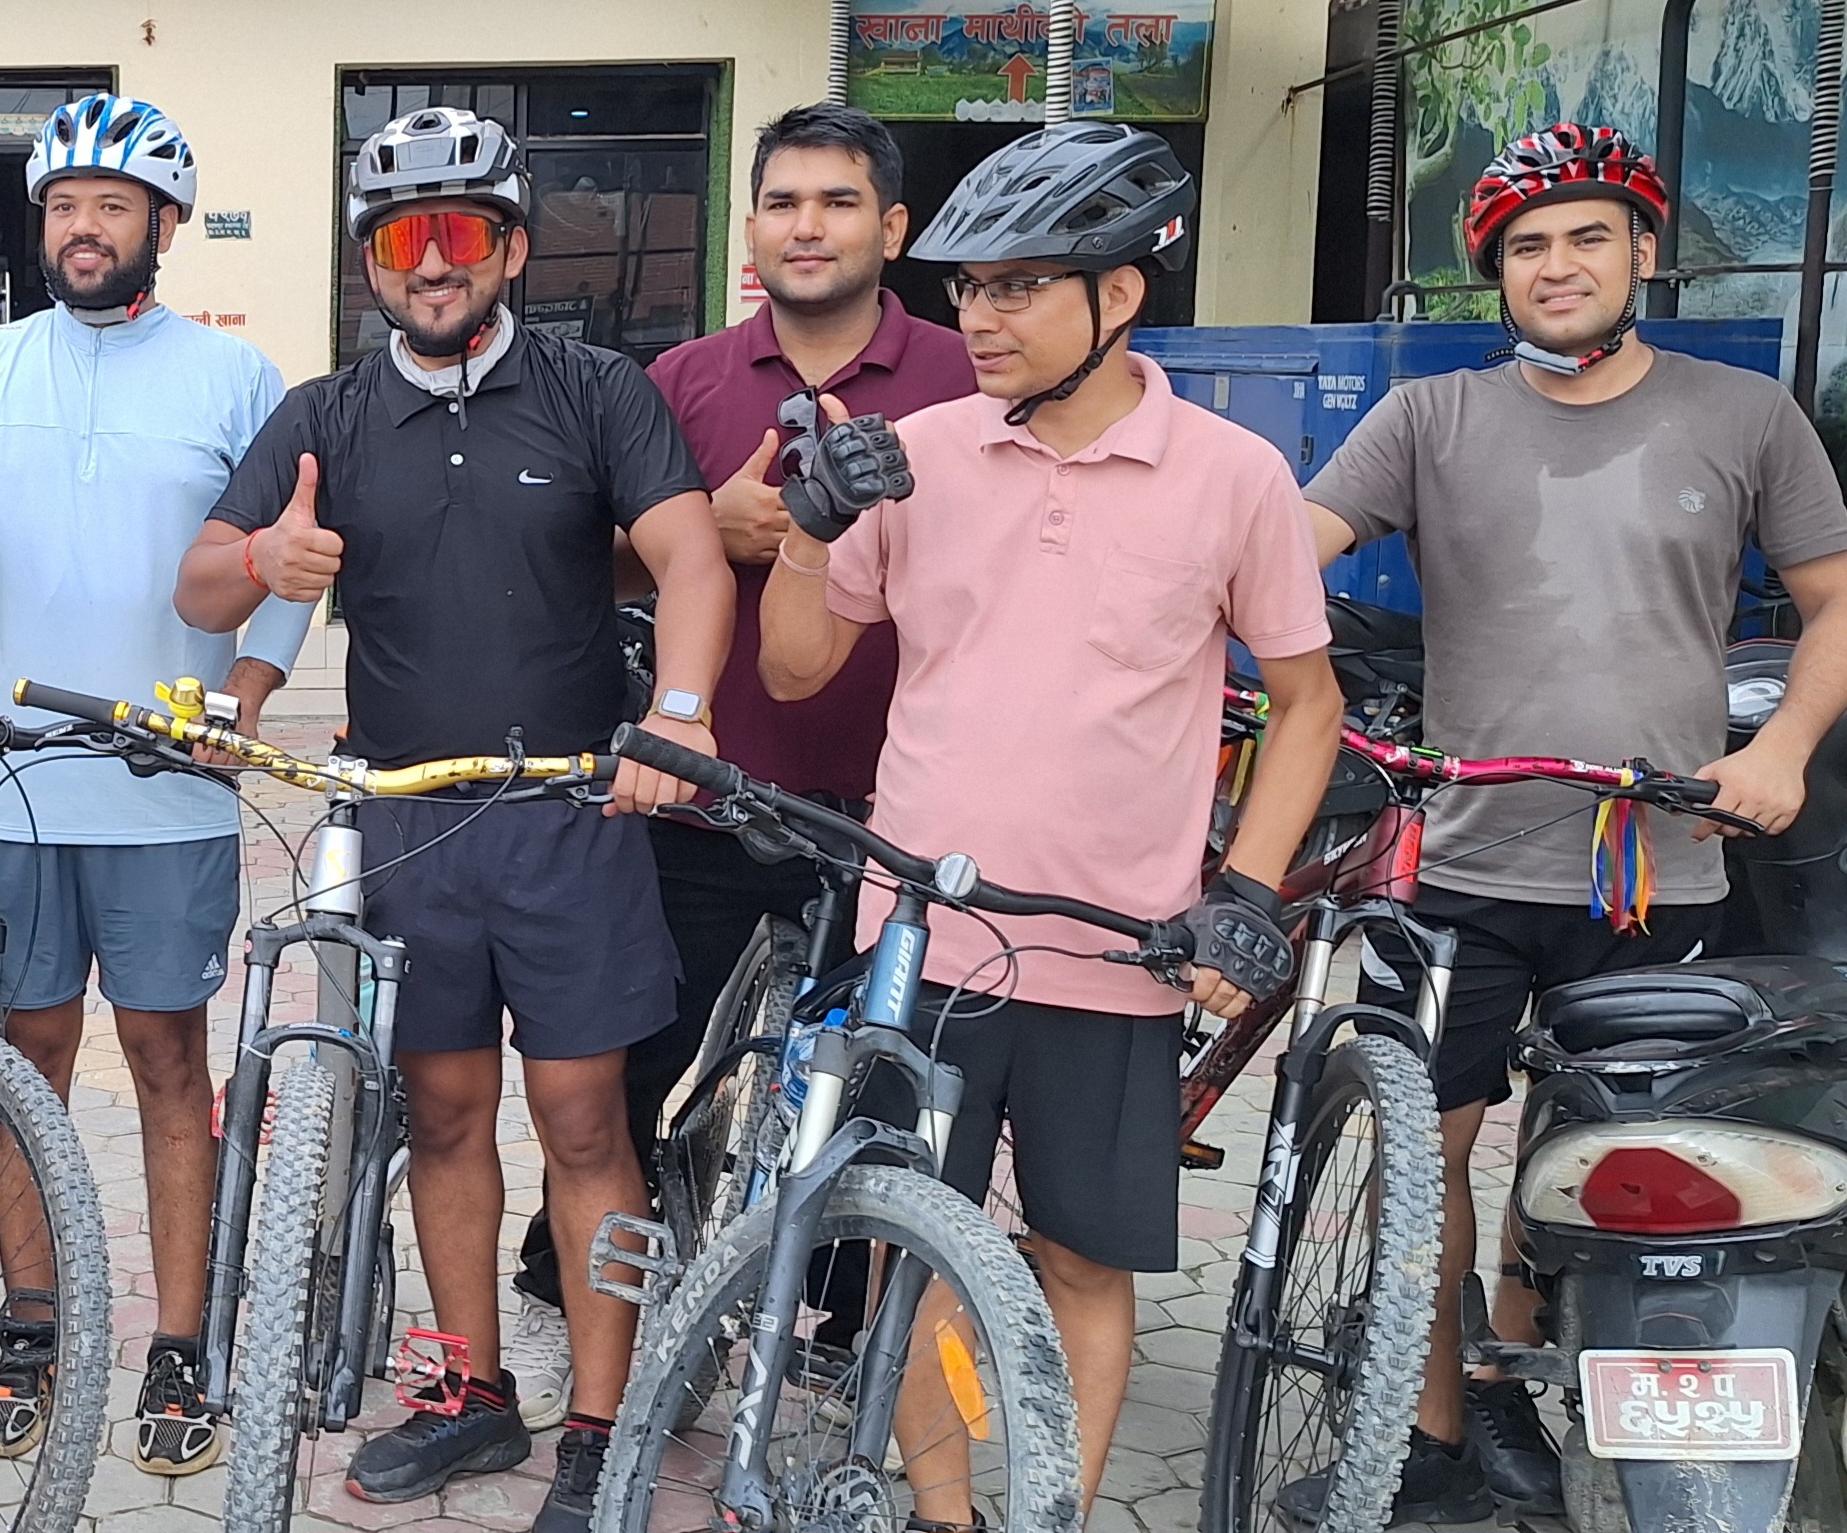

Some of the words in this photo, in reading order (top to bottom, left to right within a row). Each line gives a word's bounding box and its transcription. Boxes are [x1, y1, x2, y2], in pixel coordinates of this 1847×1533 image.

[856, 14, 949, 49] खाना
[1106, 14, 1179, 47] तला
[215, 314, 246, 327] खाना
[1318, 375, 1337, 391] TATA
[1338, 375, 1365, 391] MOTORS
[887, 927, 916, 1023] GIANT
[1640, 1254, 1703, 1278] TVS
[656, 1244, 740, 1363] KENDA
[1711, 1374, 1735, 1399] प
